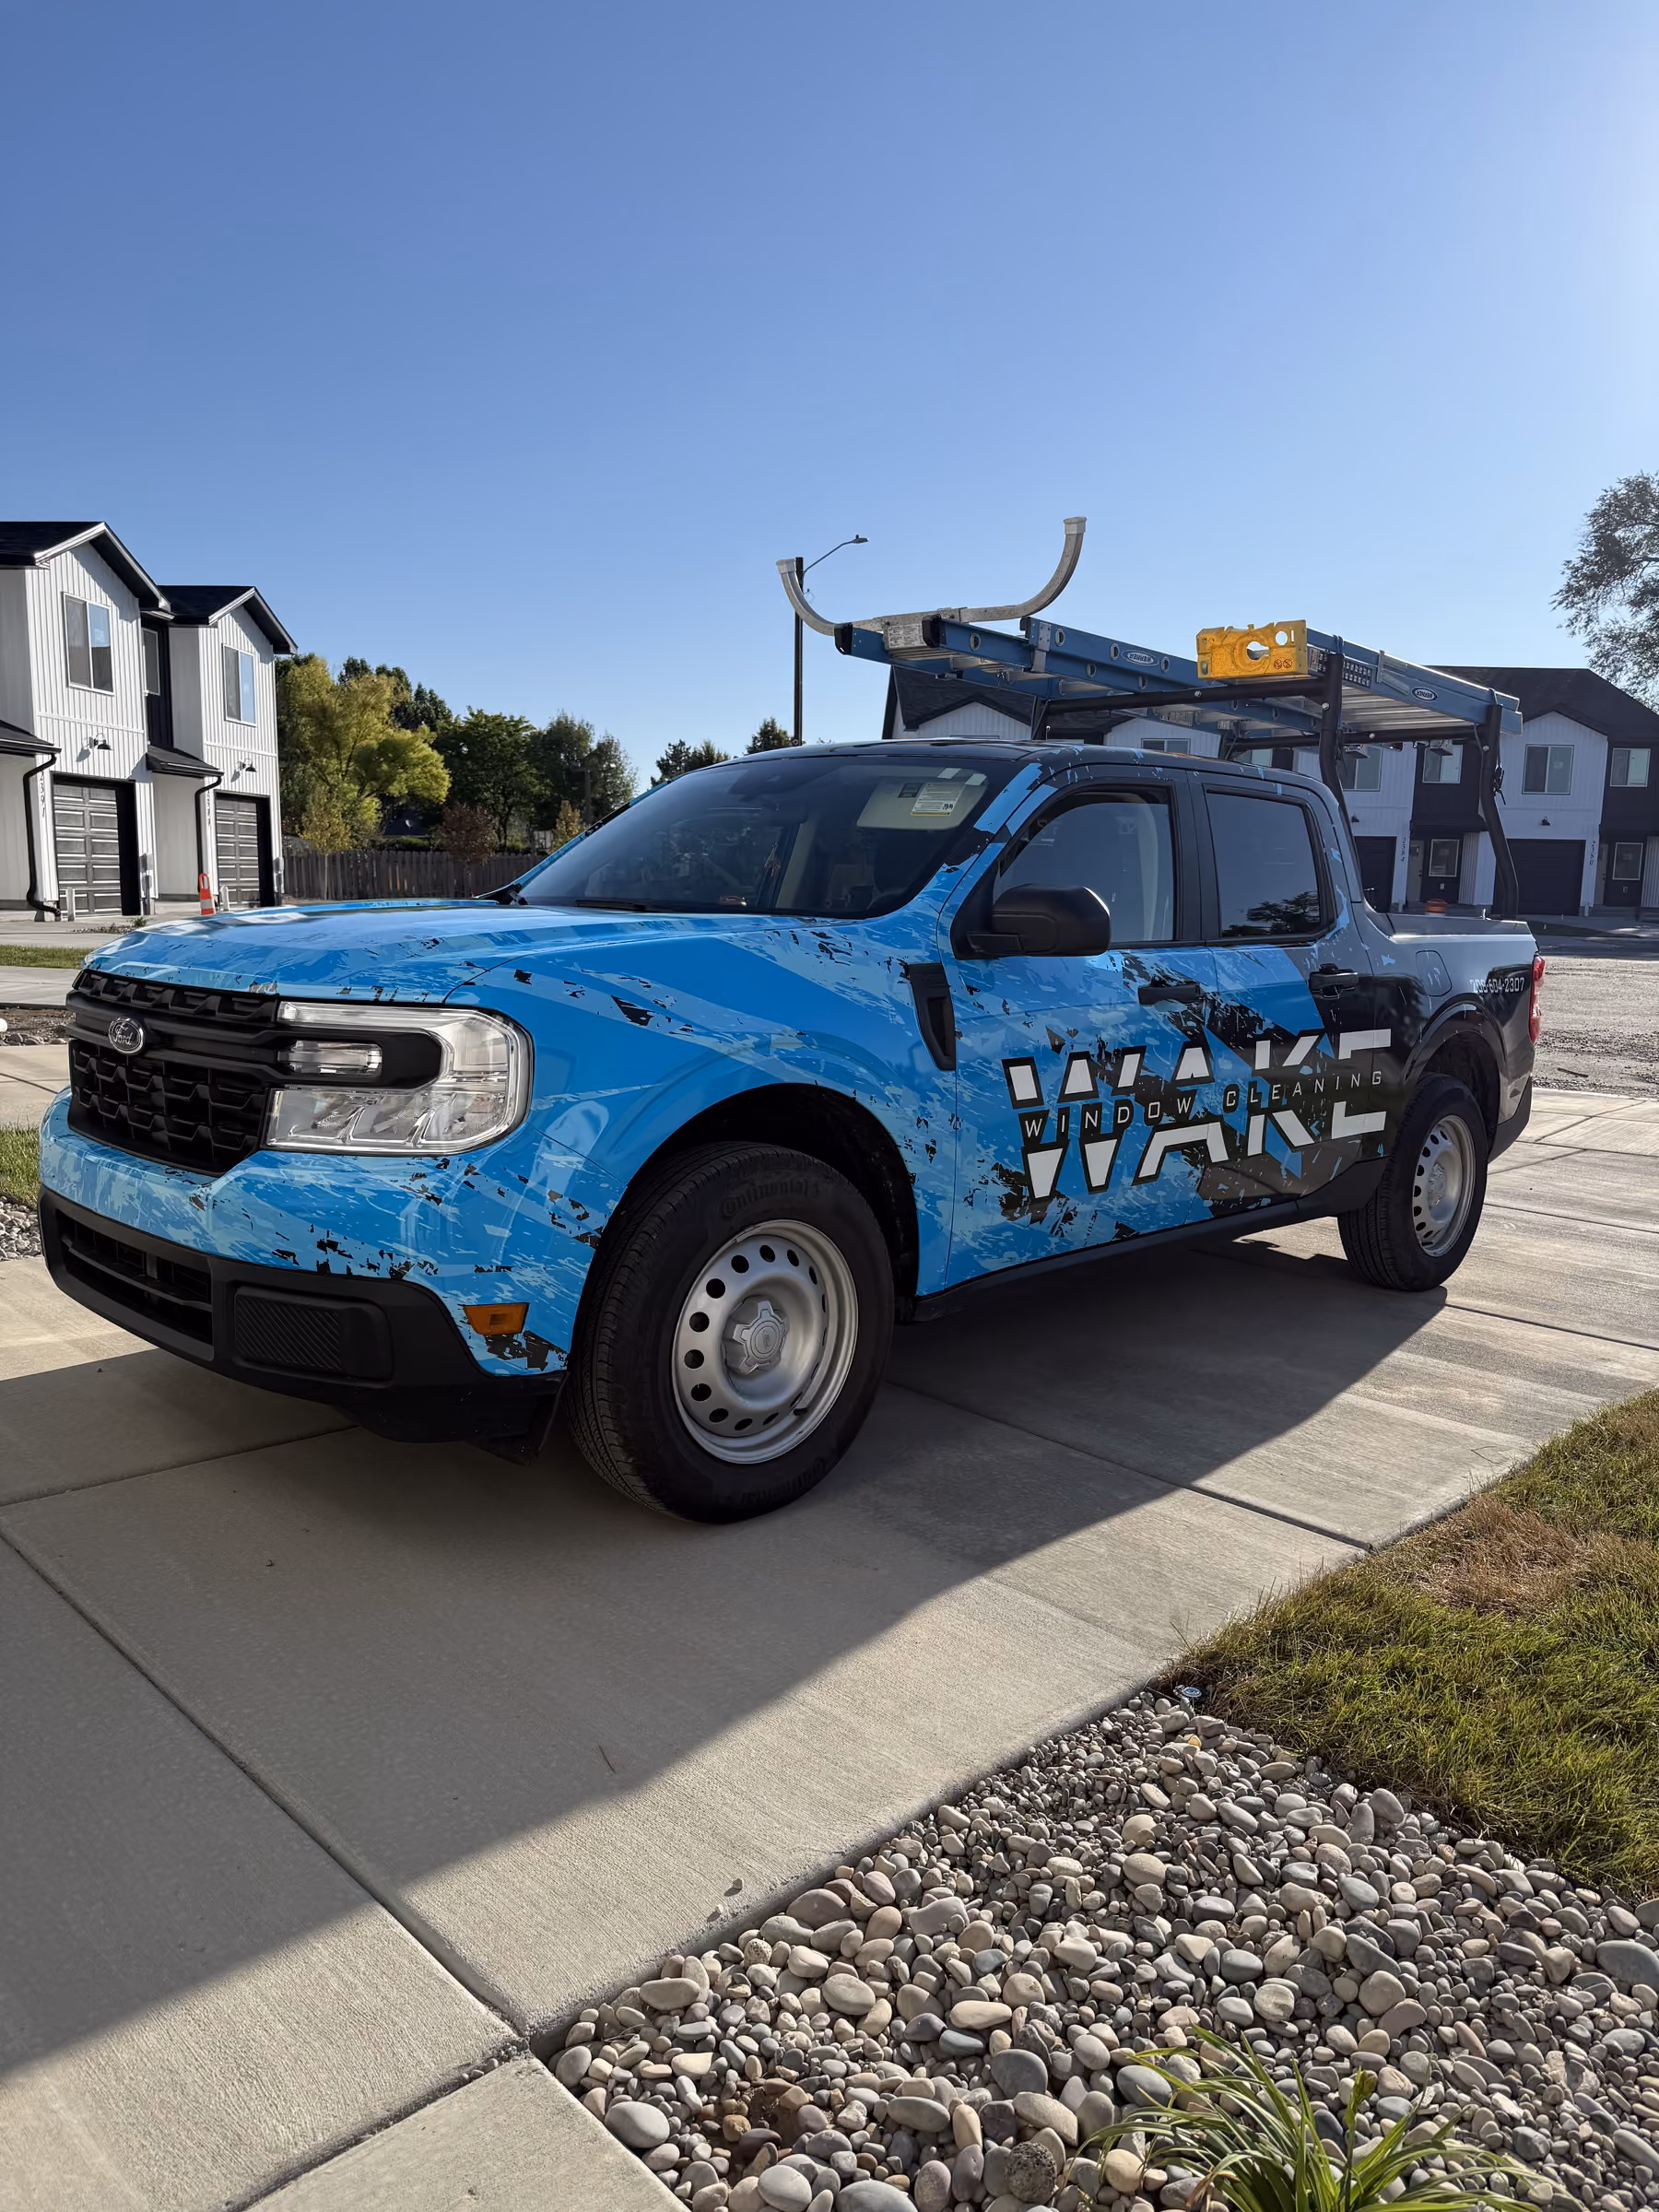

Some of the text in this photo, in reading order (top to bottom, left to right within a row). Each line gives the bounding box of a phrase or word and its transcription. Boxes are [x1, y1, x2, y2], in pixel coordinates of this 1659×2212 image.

[1127, 652, 1154, 664] WERNER
[1469, 977, 1525, 994] 208-604-2307
[112, 1024, 134, 1046] Ford
[1008, 1029, 1392, 1199] WAKE
[1025, 1070, 1382, 1138] WINDOW CLEANING
